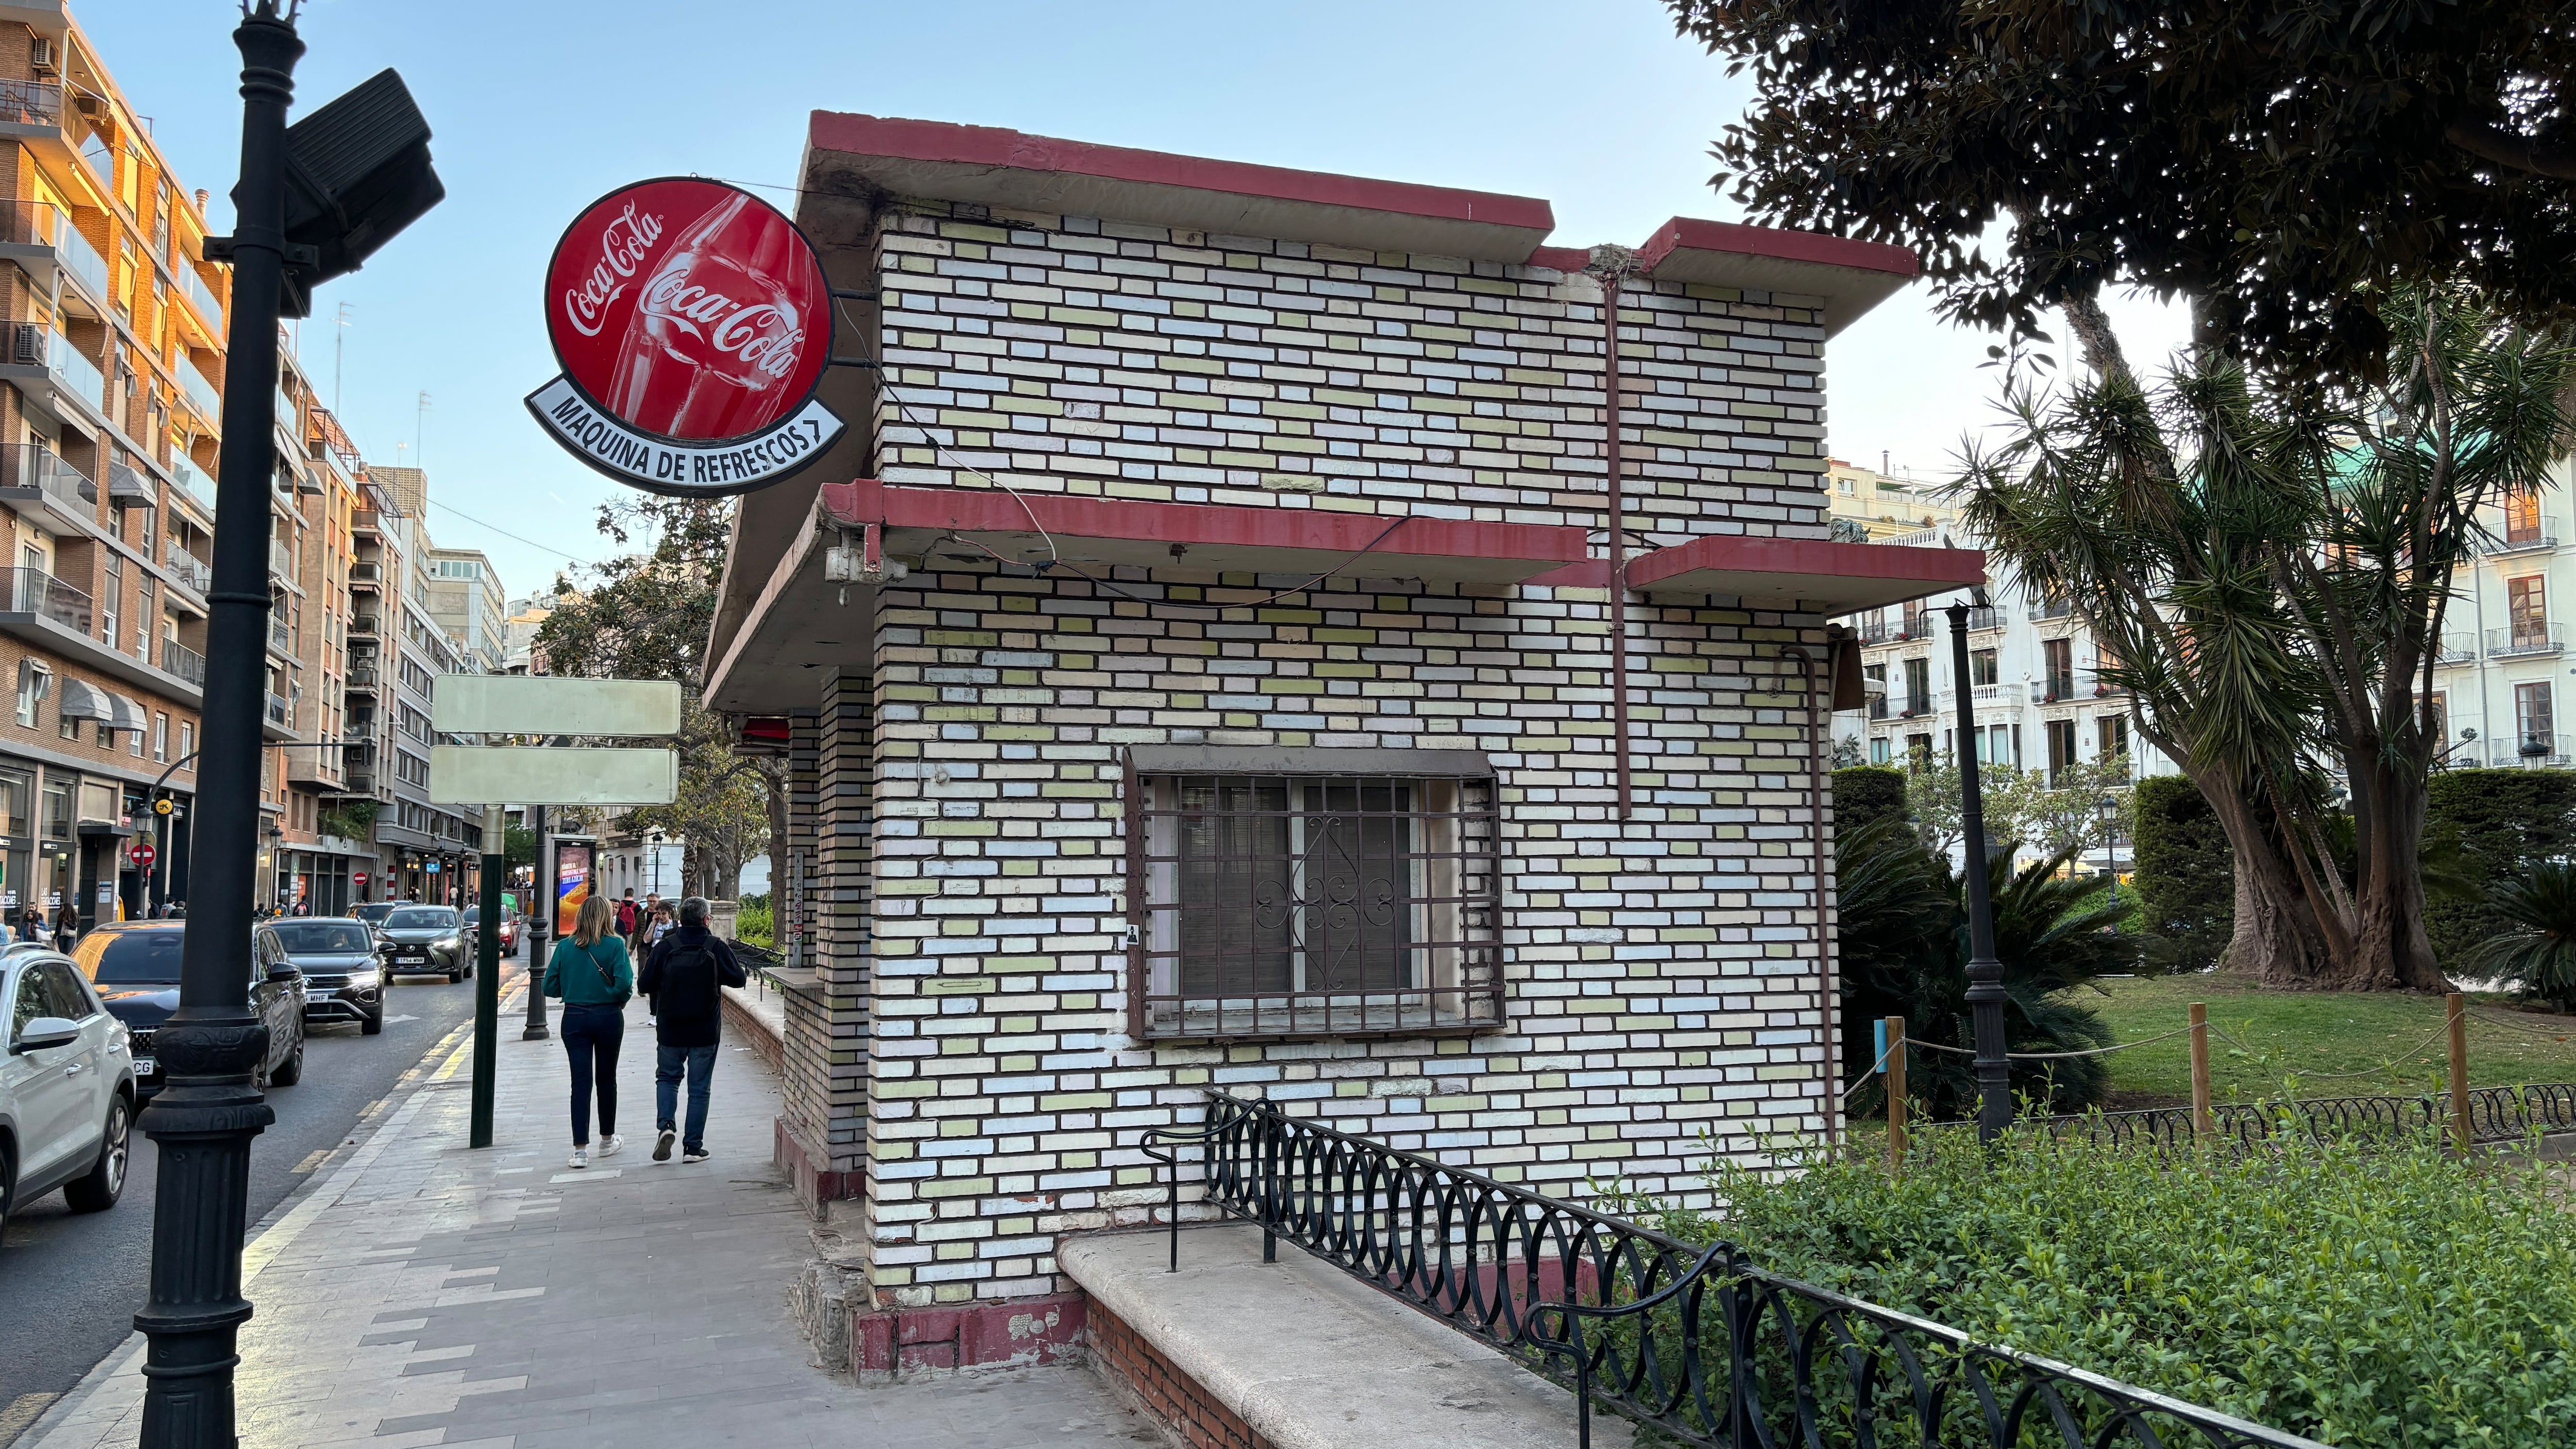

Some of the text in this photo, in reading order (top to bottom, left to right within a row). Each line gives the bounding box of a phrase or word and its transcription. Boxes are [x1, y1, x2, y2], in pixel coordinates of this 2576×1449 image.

[566, 198, 663, 336] Coca-Cola
[639, 269, 804, 379] Coca-Cola
[551, 396, 809, 483] MAQUINA DE REFRESCOS
